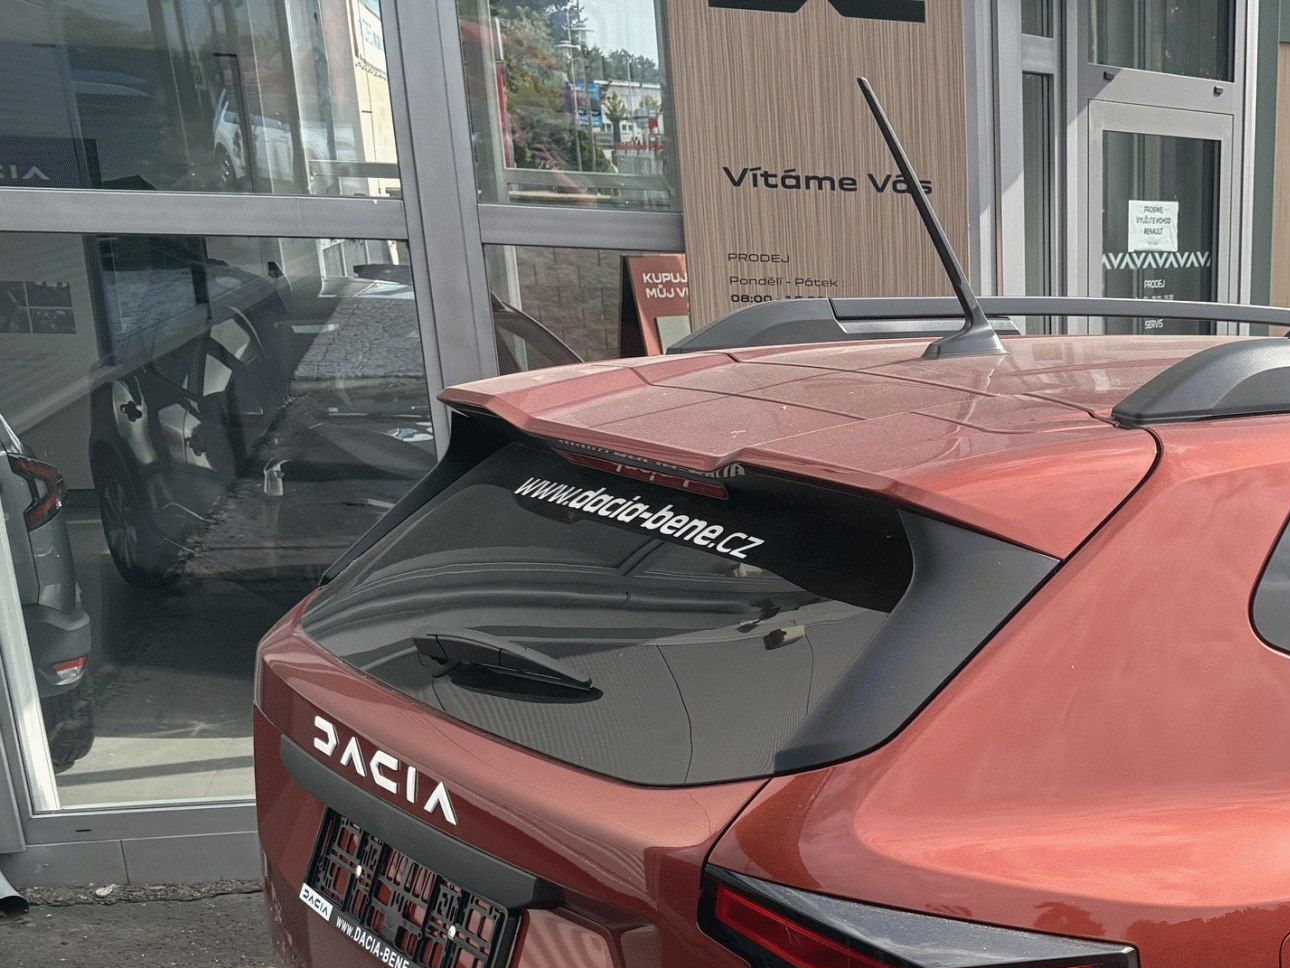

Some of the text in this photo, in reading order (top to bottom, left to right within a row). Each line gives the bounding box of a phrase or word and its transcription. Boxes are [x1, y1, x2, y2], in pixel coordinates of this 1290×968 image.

[0, 164, 50, 180] IA
[722, 166, 858, 192] Vítáme
[728, 253, 790, 263] PRODEJ
[729, 276, 783, 287] Pondělí
[795, 277, 839, 288] Pátek
[645, 284, 675, 298] MŮJ
[731, 294, 773, 303] 08:00
[513, 476, 766, 560] www.dacia-bene.cz
[313, 714, 459, 826] DACIA
[302, 888, 329, 917] DACIA
